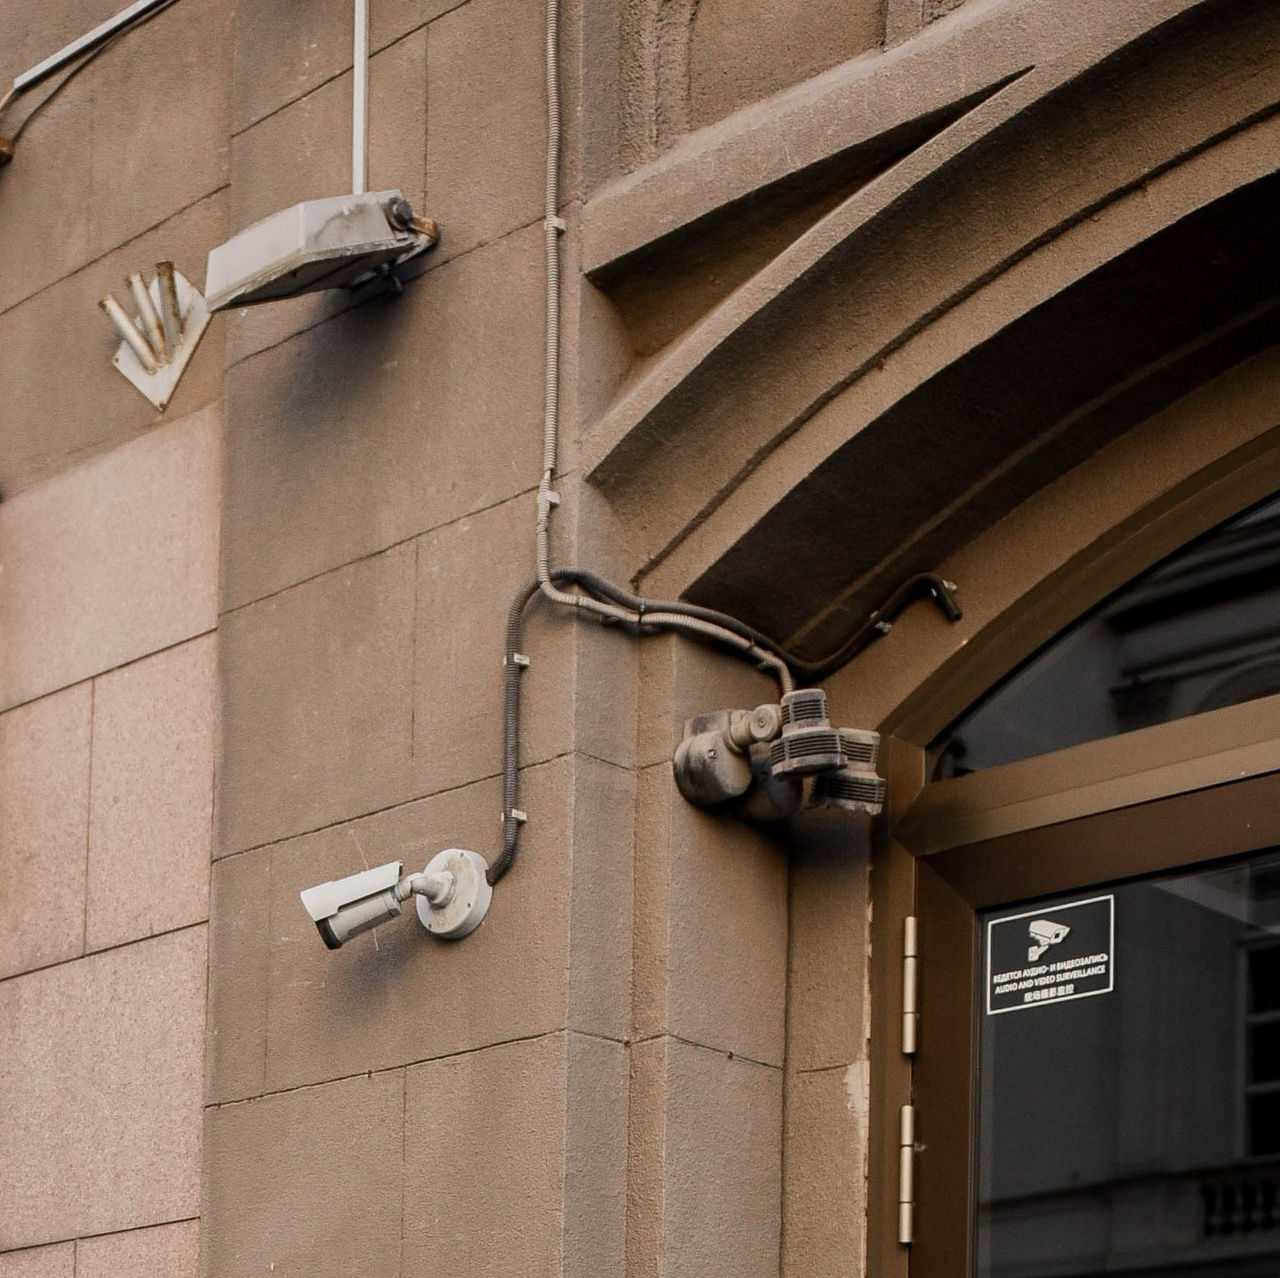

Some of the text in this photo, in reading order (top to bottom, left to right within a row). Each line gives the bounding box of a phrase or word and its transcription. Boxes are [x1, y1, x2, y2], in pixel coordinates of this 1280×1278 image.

[993, 970, 1022, 984] ВЕДЕТСЯ
[1050, 964, 1056, 972] И
[1057, 953, 1108, 971] ВИДЕОЗАПИСЬ
[994, 965, 1106, 995] AUDIO AND VIDEO SURVEILLANCE
